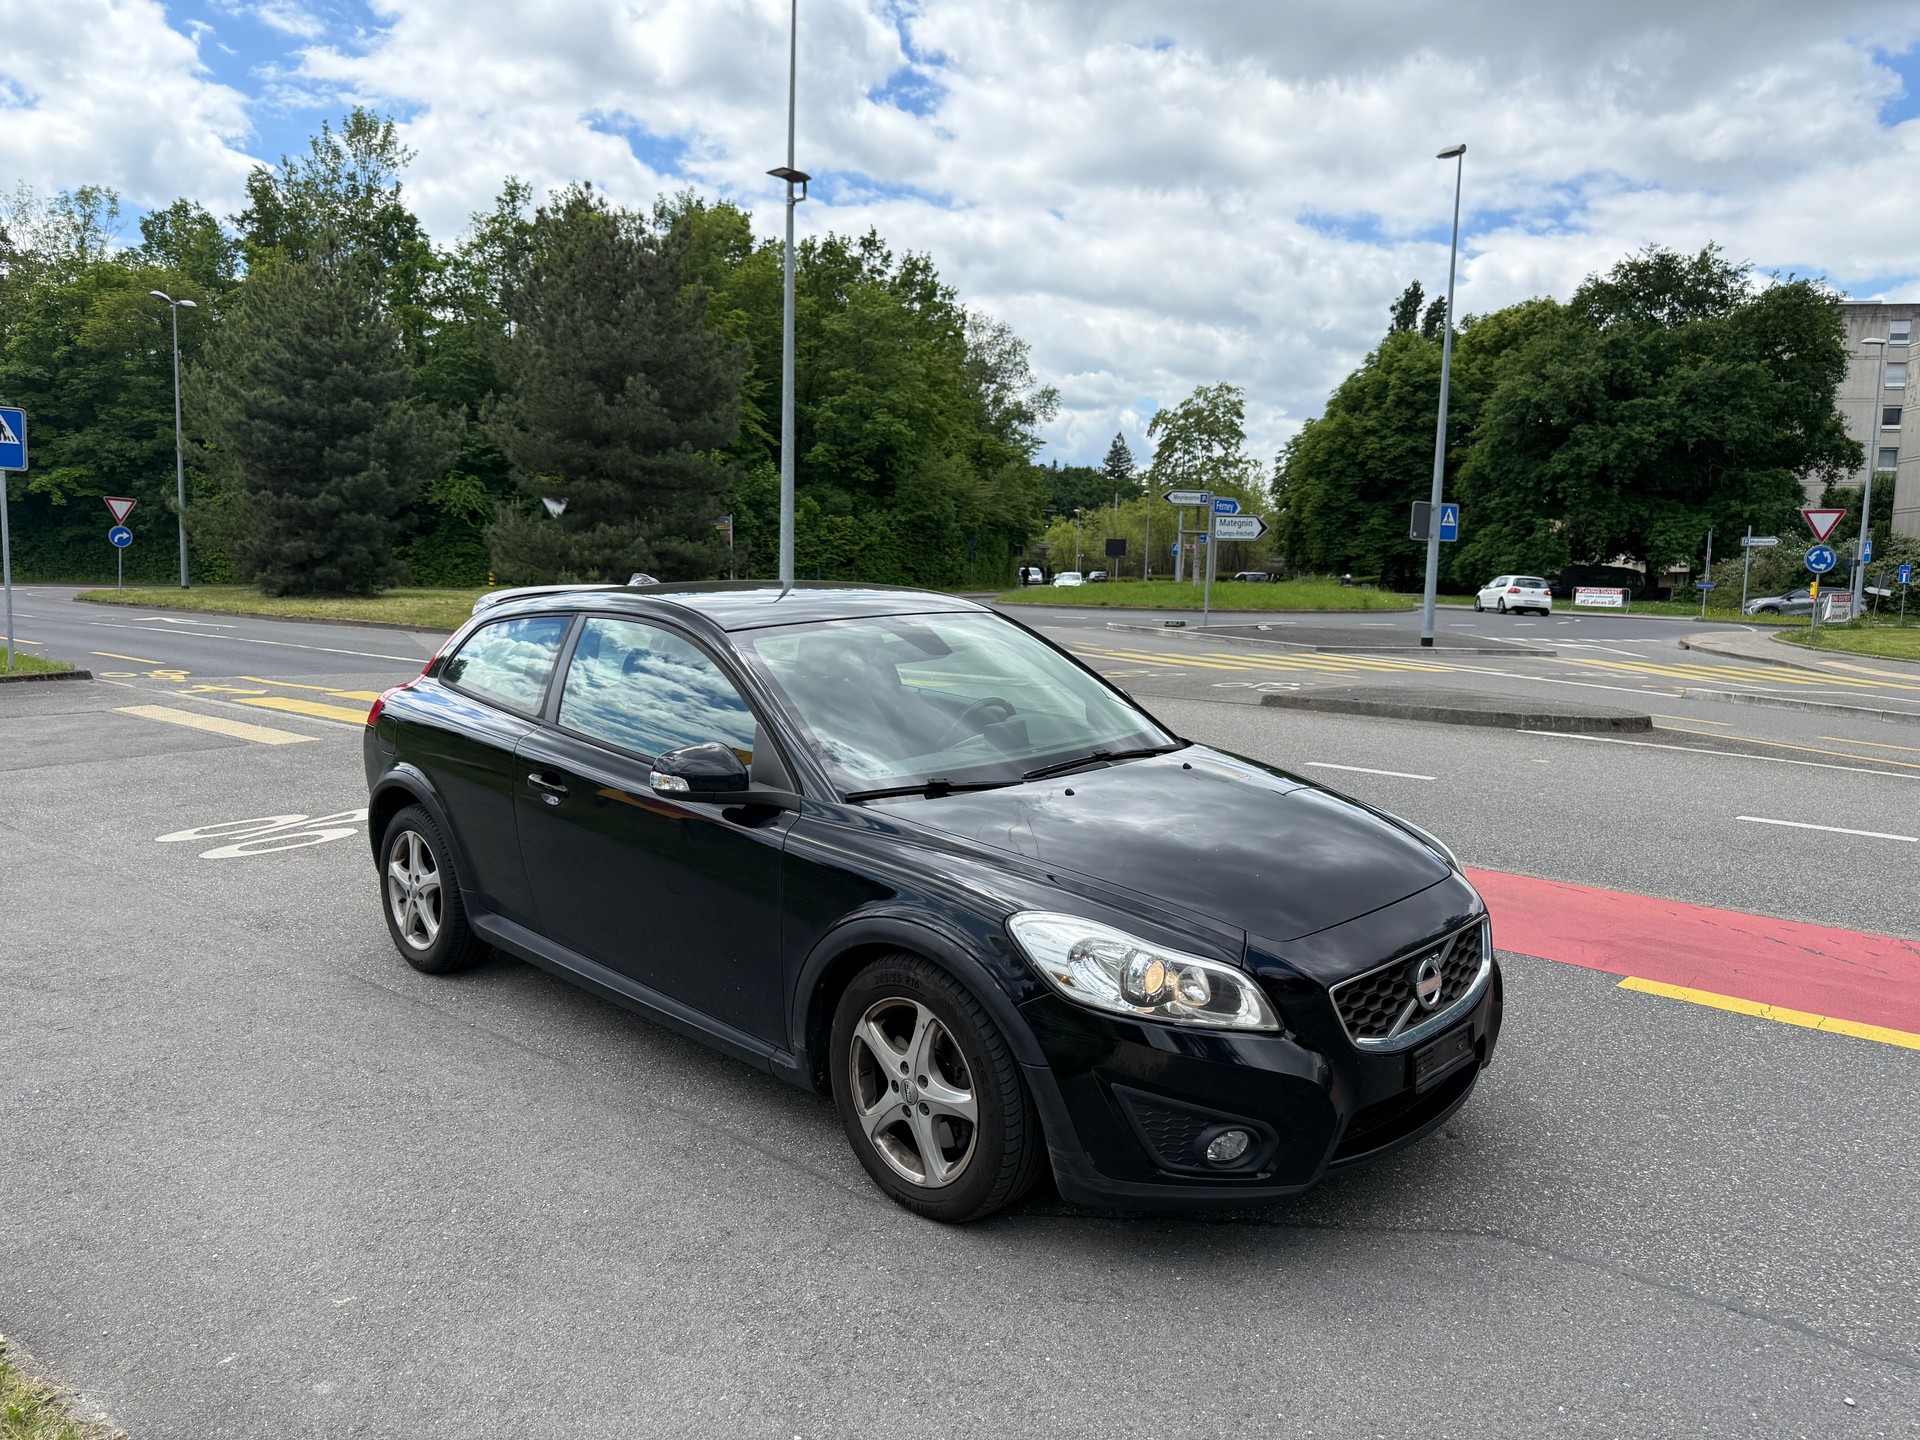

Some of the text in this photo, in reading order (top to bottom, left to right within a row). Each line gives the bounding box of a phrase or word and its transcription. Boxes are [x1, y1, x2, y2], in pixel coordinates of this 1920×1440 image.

[1216, 501, 1233, 513] Ferney
[1219, 518, 1253, 529] Mategnin
[874, 974, 920, 989] 205/55 R16
